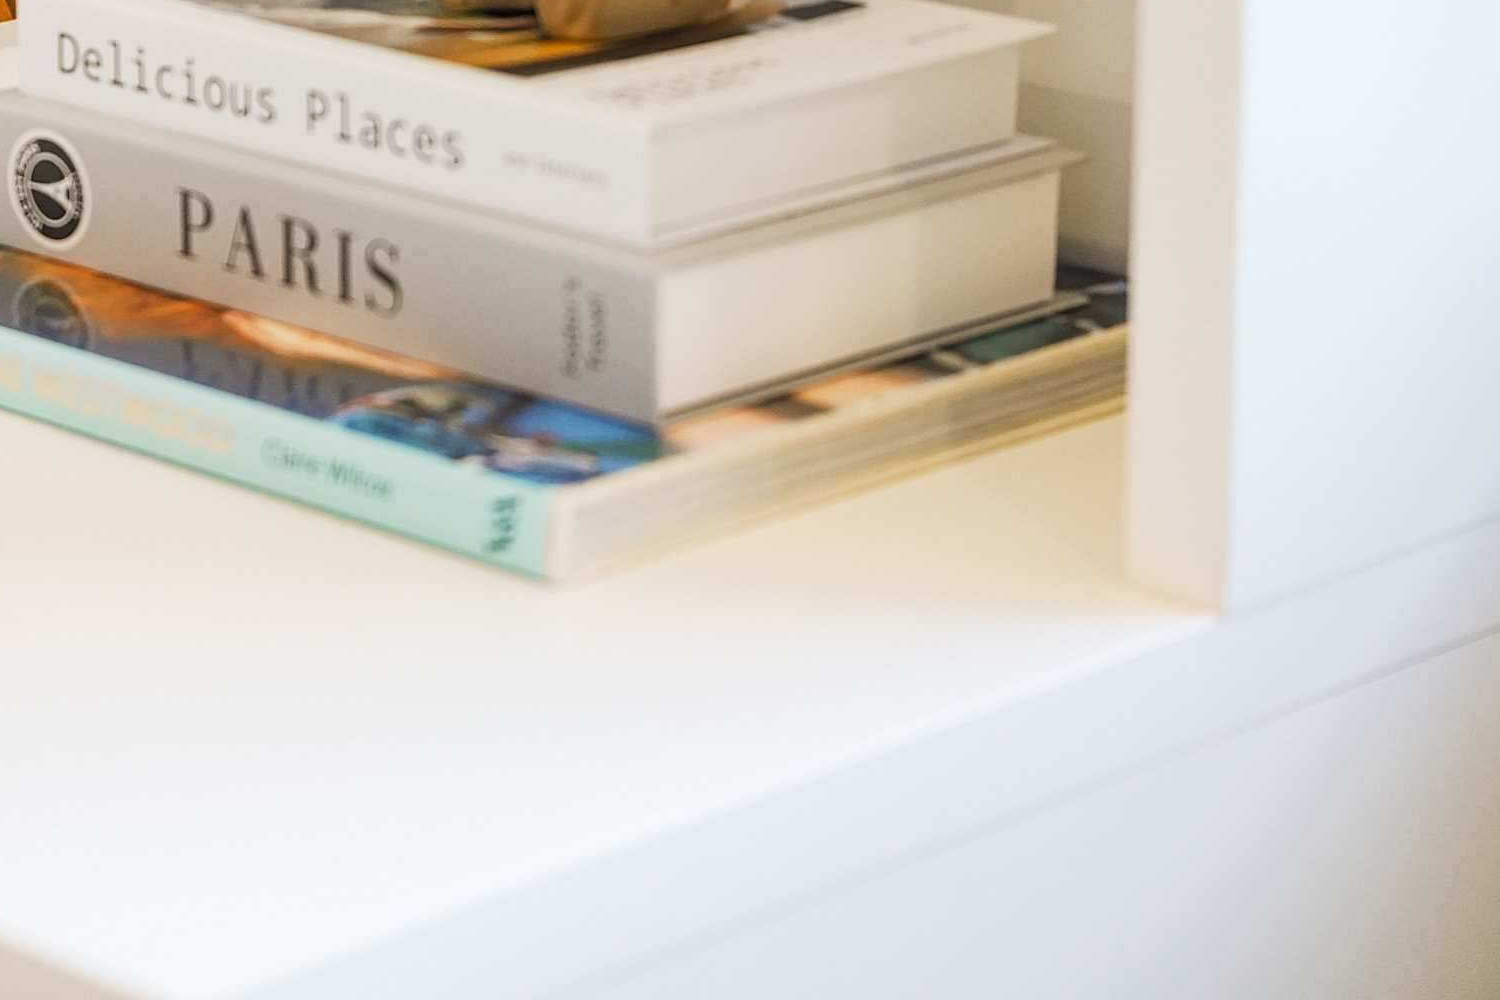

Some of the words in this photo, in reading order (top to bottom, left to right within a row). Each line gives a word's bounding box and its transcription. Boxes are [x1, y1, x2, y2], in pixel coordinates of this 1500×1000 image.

[54, 31, 278, 126] Delicious
[304, 88, 465, 171] Places
[175, 185, 405, 318] PARIS
